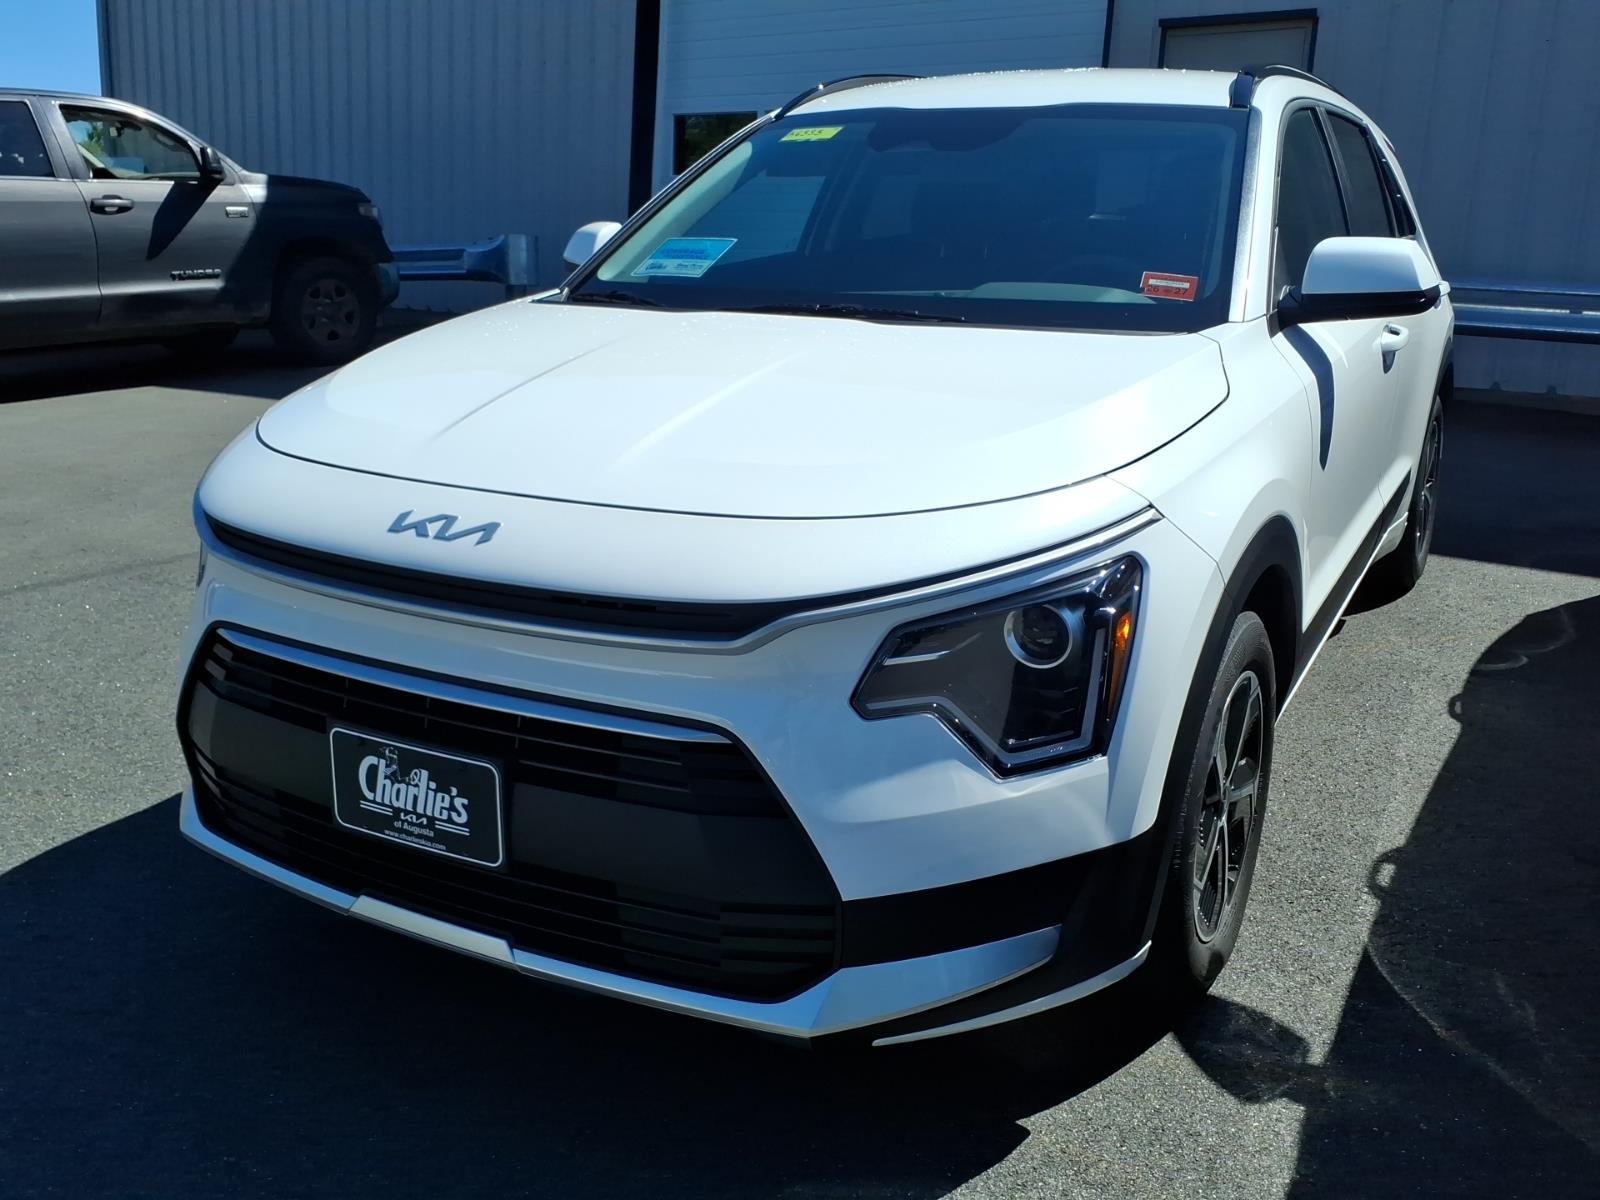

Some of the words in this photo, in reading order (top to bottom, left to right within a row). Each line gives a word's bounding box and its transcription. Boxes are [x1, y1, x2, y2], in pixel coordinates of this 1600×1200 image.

[387, 509, 502, 546] KIA
[358, 755, 469, 824] Charlie's
[402, 822, 435, 838] Augusta
